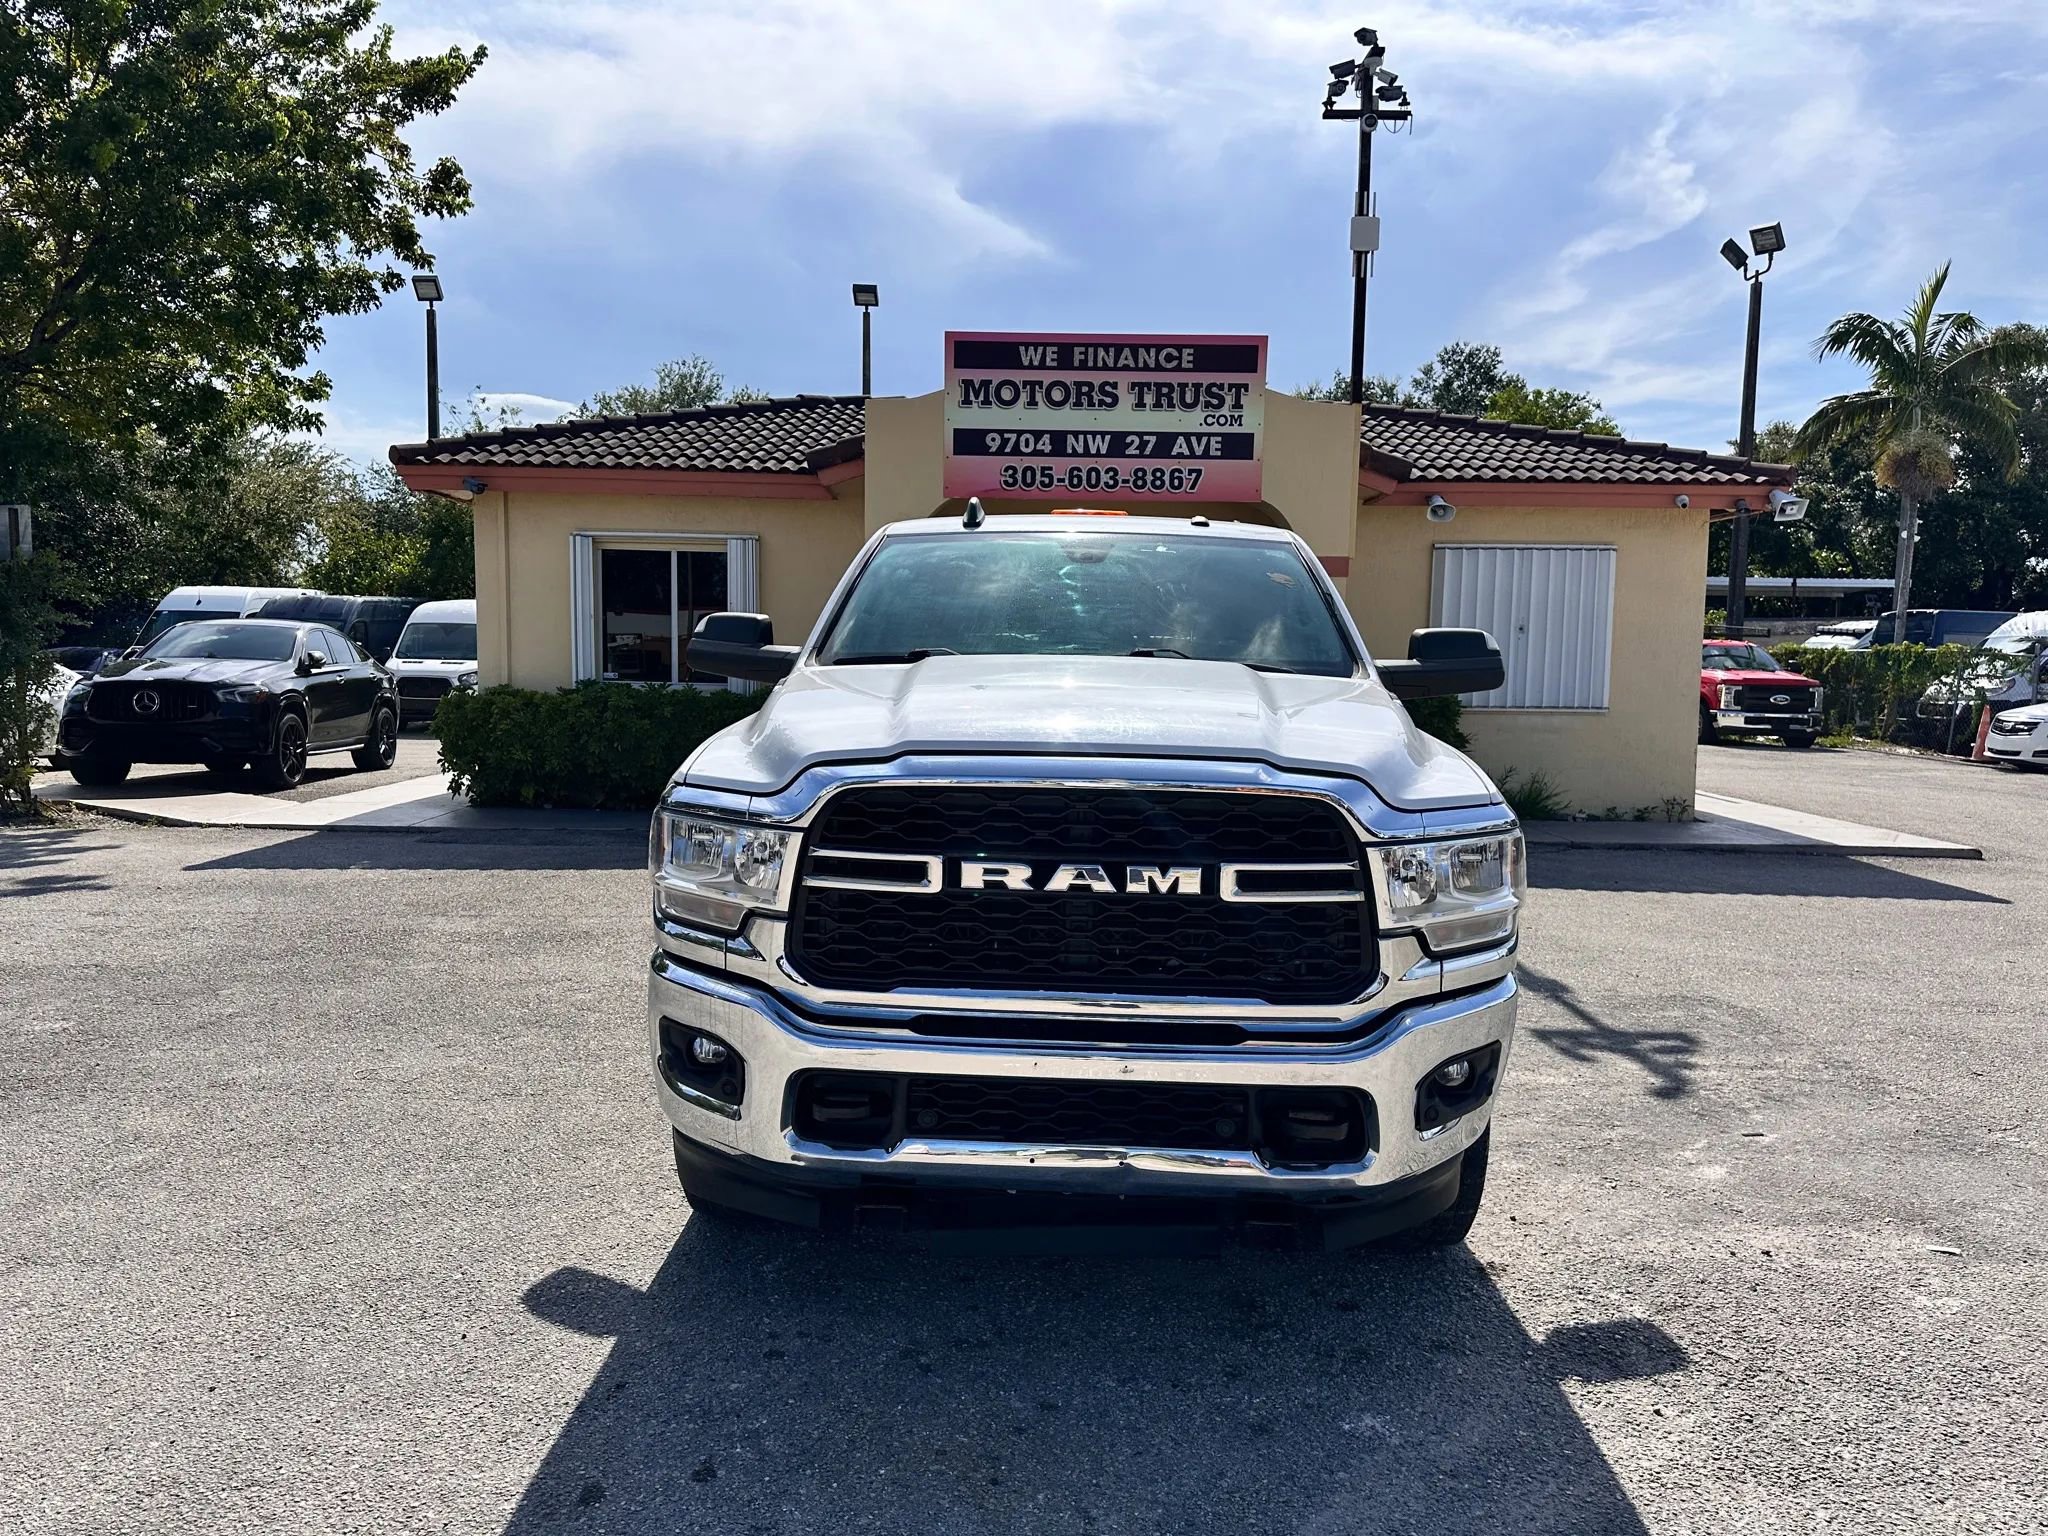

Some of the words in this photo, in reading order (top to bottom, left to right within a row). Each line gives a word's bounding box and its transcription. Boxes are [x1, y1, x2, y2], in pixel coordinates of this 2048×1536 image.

[1019, 346, 1058, 367] WE
[1073, 347, 1194, 369] FINANCE
[959, 378, 1119, 409] MOTORS
[1130, 381, 1250, 411] TRUST
[1199, 414, 1243, 427] .COM
[985, 433, 1052, 453] 9704
[1066, 435, 1111, 454] NW
[1125, 435, 1157, 455] 27
[1171, 436, 1222, 456] AVE
[1001, 464, 1204, 492] 305-603-8867
[961, 861, 1202, 895] RAM
